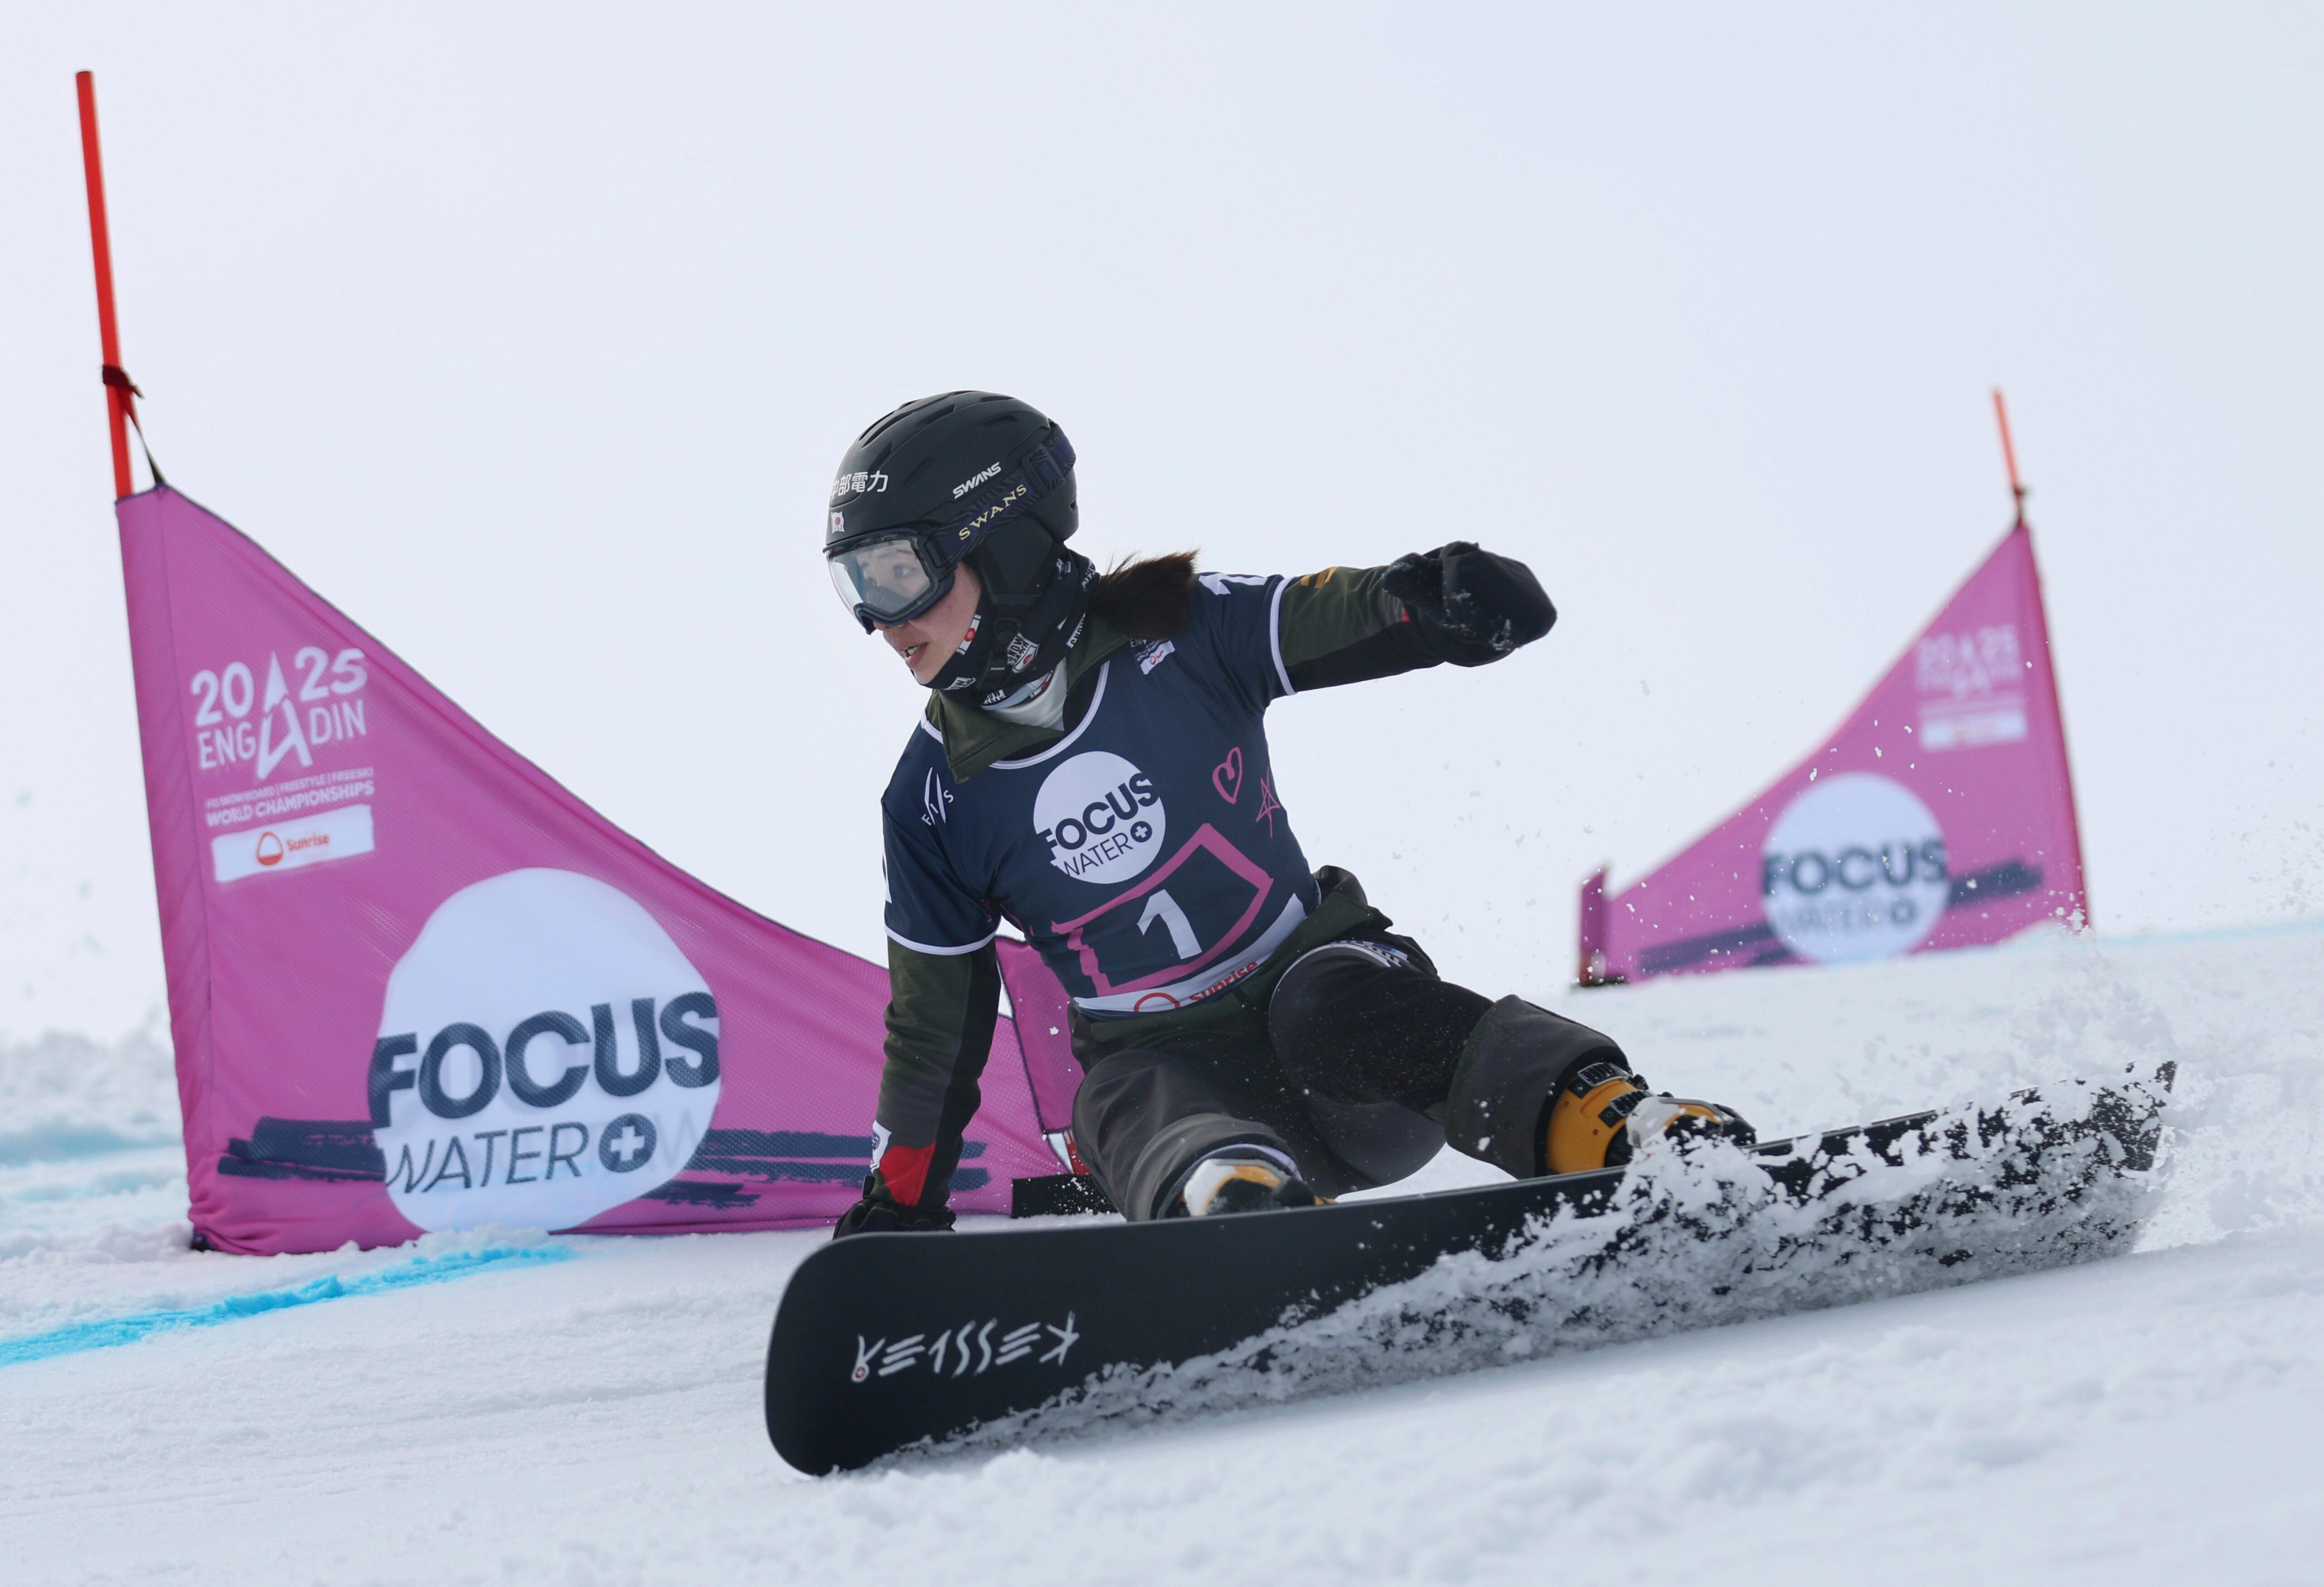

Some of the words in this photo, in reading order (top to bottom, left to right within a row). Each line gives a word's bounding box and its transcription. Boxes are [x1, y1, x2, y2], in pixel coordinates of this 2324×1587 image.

[831, 470, 889, 500] 中部電力
[953, 461, 1001, 499] SWANS
[959, 484, 1027, 540] SWANS
[1008, 636, 1023, 661] SNOW
[206, 804, 254, 827] WORLD
[255, 780, 375, 817] CHAMPIONSHIPS
[1037, 773, 1159, 862] FOCUS
[286, 833, 330, 851] Sunrise
[1762, 838, 1947, 896] FOCUS
[1137, 889, 1202, 959] 1
[1189, 961, 1258, 1001] Sunrise
[368, 991, 721, 1129] FOCUS
[386, 1122, 590, 1194] WATER
